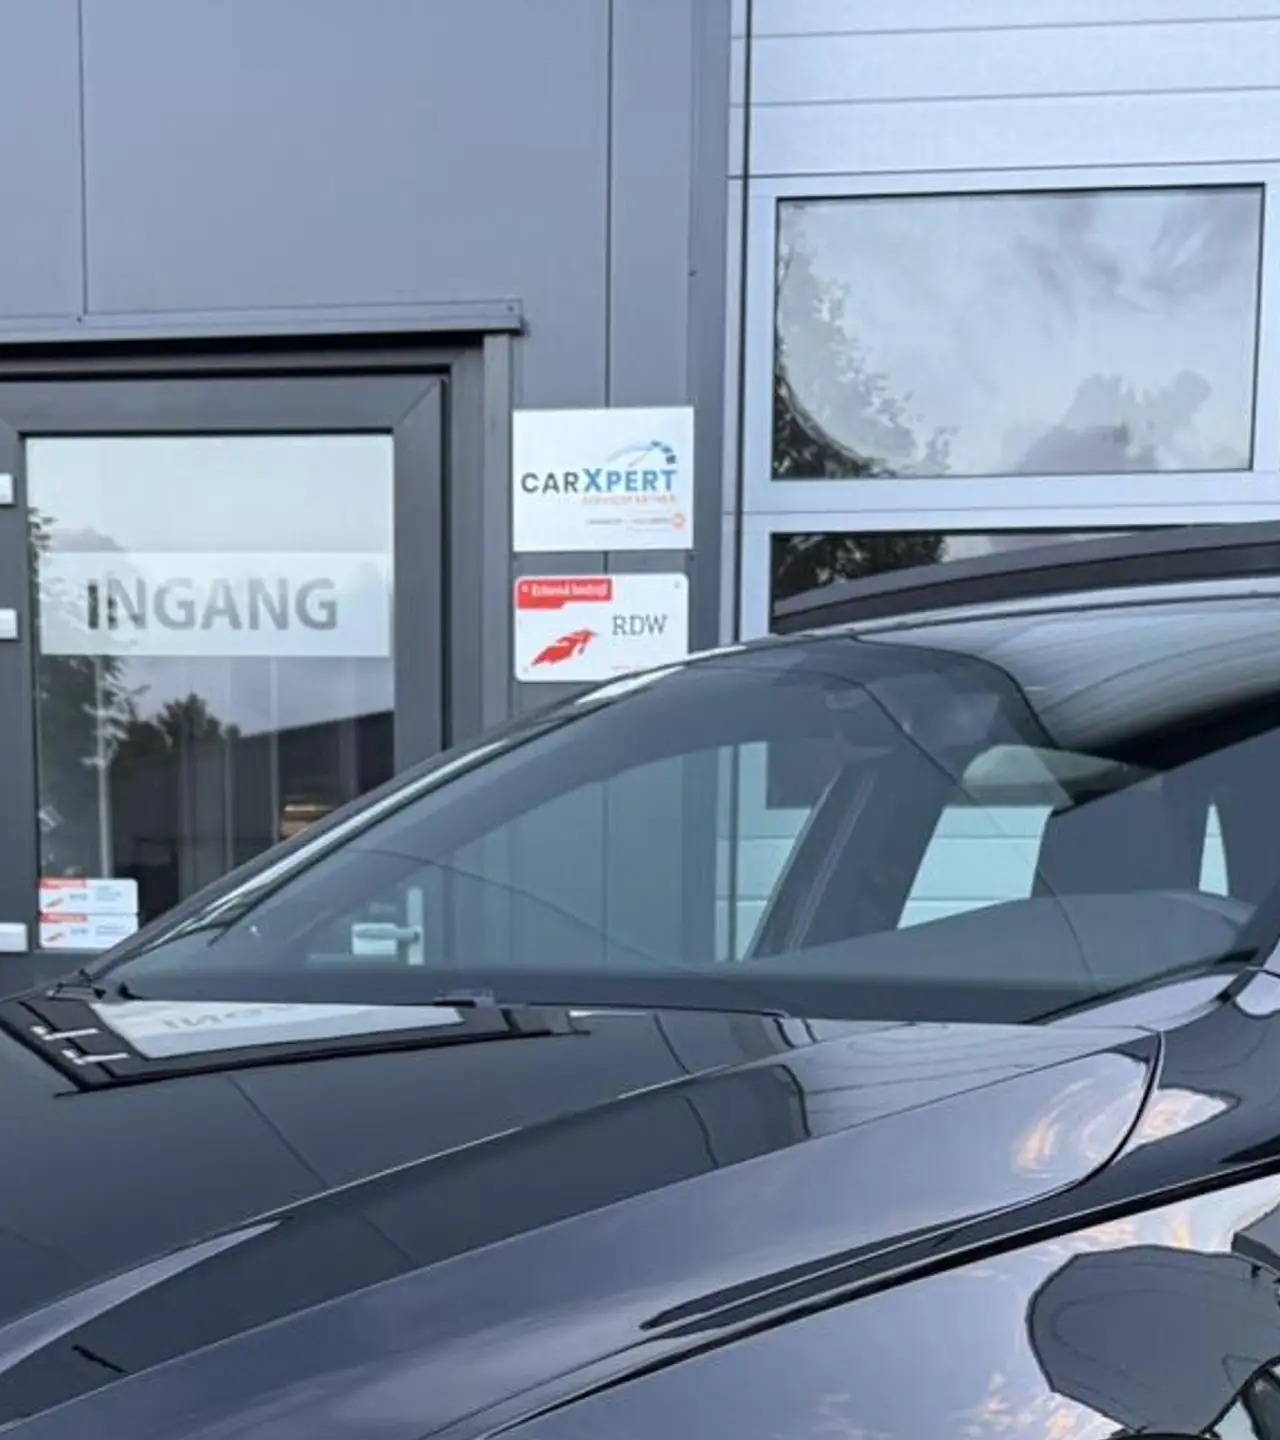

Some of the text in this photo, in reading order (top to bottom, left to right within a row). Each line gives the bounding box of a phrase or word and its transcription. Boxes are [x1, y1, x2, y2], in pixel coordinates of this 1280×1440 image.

[521, 468, 677, 494] CARXPERT
[87, 577, 338, 631] INGANG
[612, 614, 667, 636] RDW
